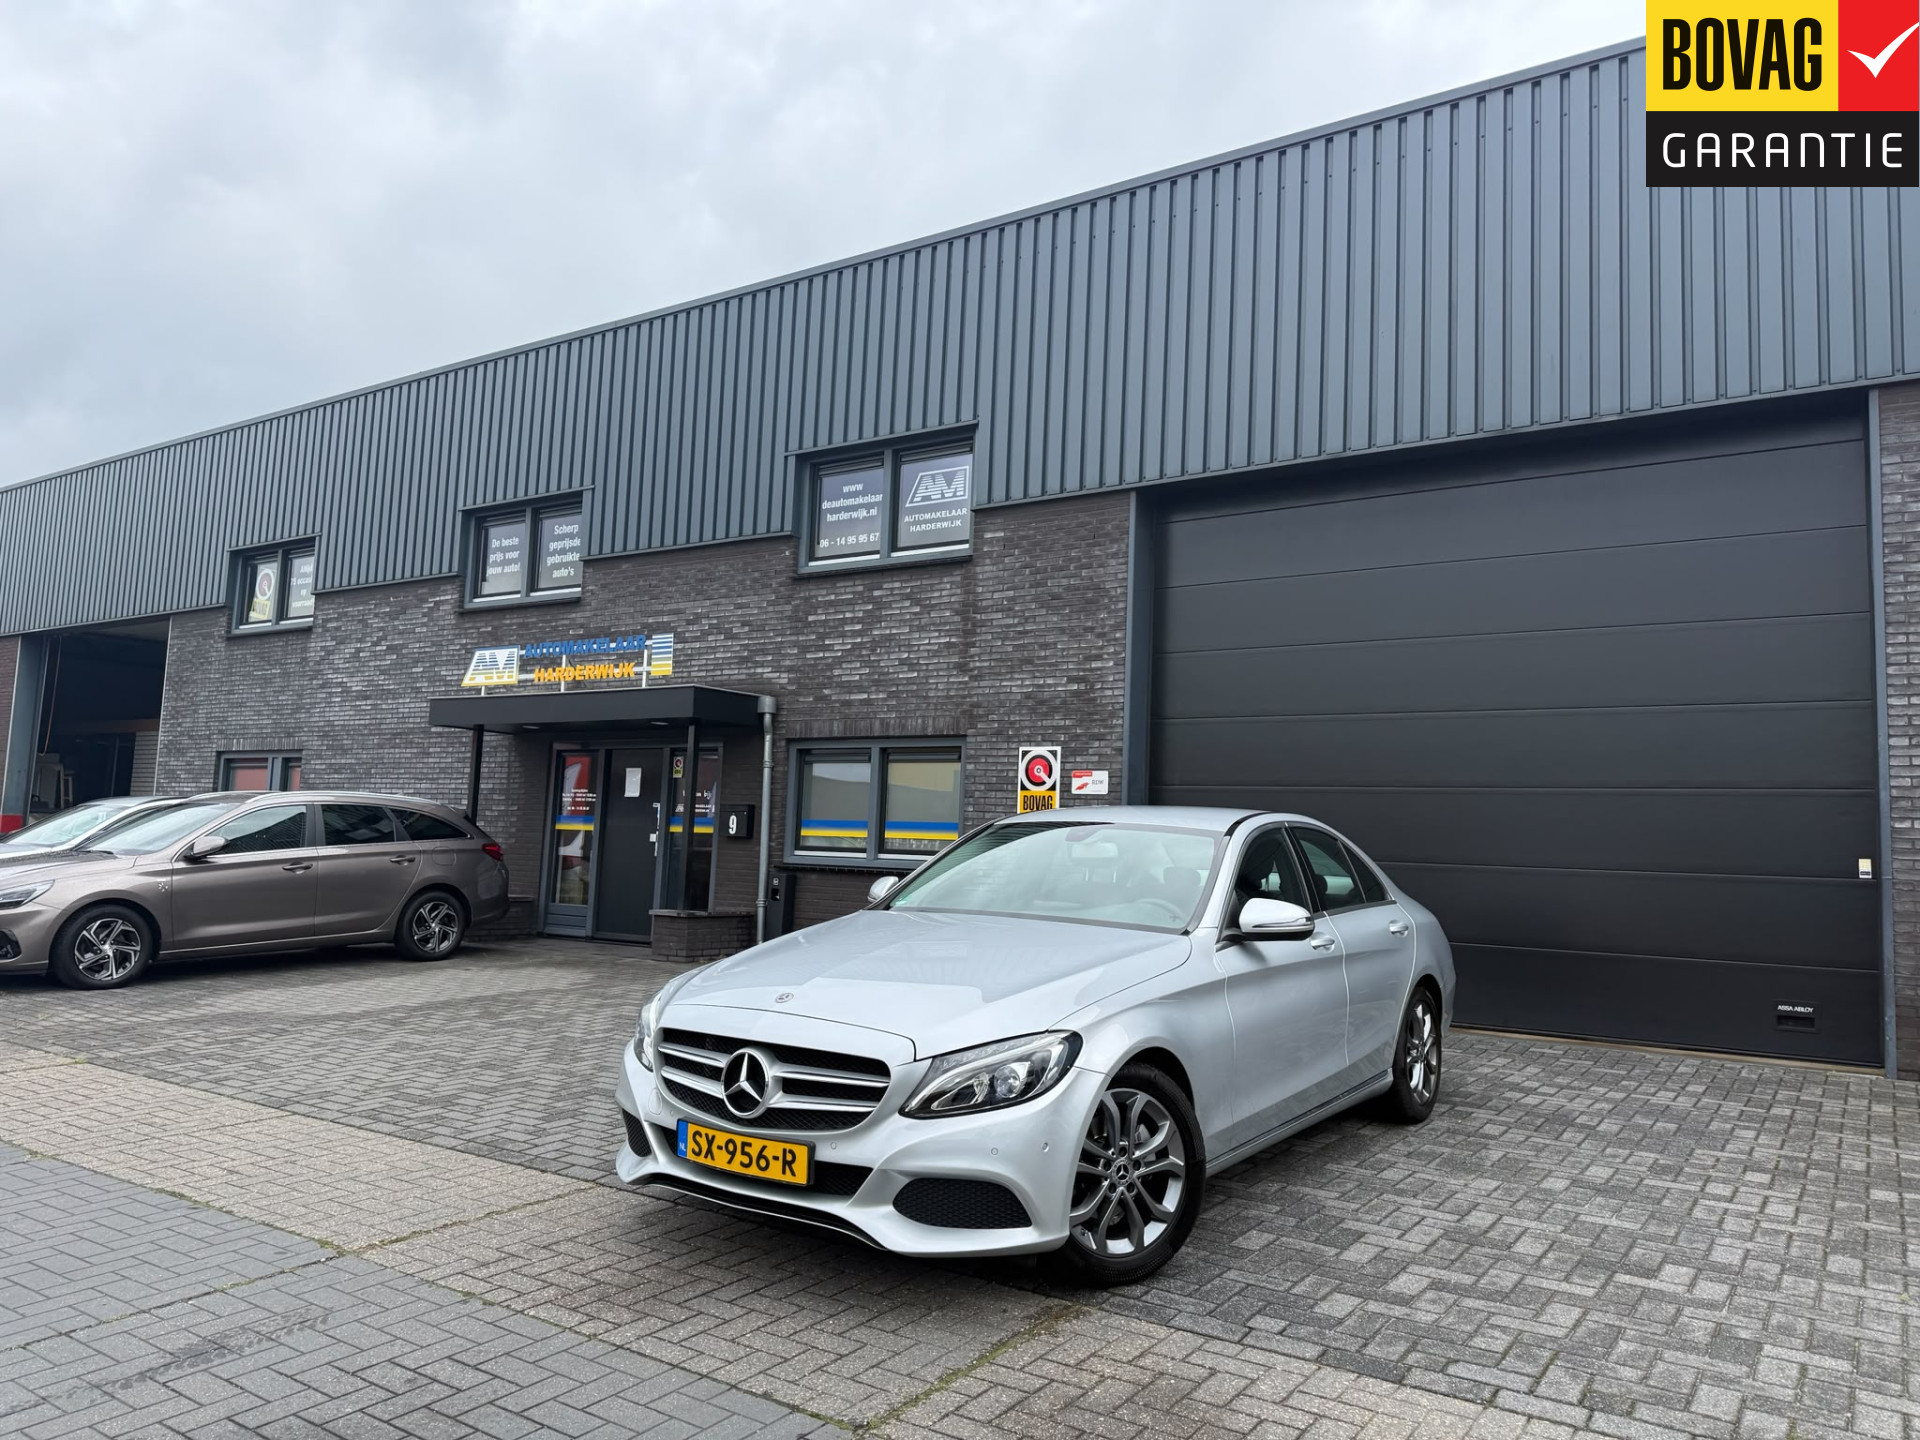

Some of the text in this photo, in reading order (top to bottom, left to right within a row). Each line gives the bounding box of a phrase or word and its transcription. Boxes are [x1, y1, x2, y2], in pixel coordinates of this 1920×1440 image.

[842, 482, 864, 493] www
[821, 493, 884, 510] deautomakelaar
[826, 507, 878, 523] harderwijk.nl
[903, 507, 968, 523] AUTOMAKELAAR
[554, 523, 579, 536] Scherp
[909, 519, 963, 533] HARDERWIJK
[491, 536, 520, 548] De beste
[548, 538, 581, 552] geprijsde
[819, 537, 829, 548] 06
[836, 536, 847, 547] 14
[847, 534, 858, 545] 95
[858, 533, 869, 544] 95
[869, 532, 881, 543] 67
[489, 550, 521, 563] prijs voor
[546, 551, 580, 566] gebruikte
[552, 567, 575, 579] auto's
[523, 634, 647, 659] AUTOMAKELAAR
[533, 661, 636, 684] HARDERWIJK
[1022, 794, 1053, 811] BOVAG
[728, 815, 737, 835] 9
[690, 1130, 797, 1177] SX-956-R
